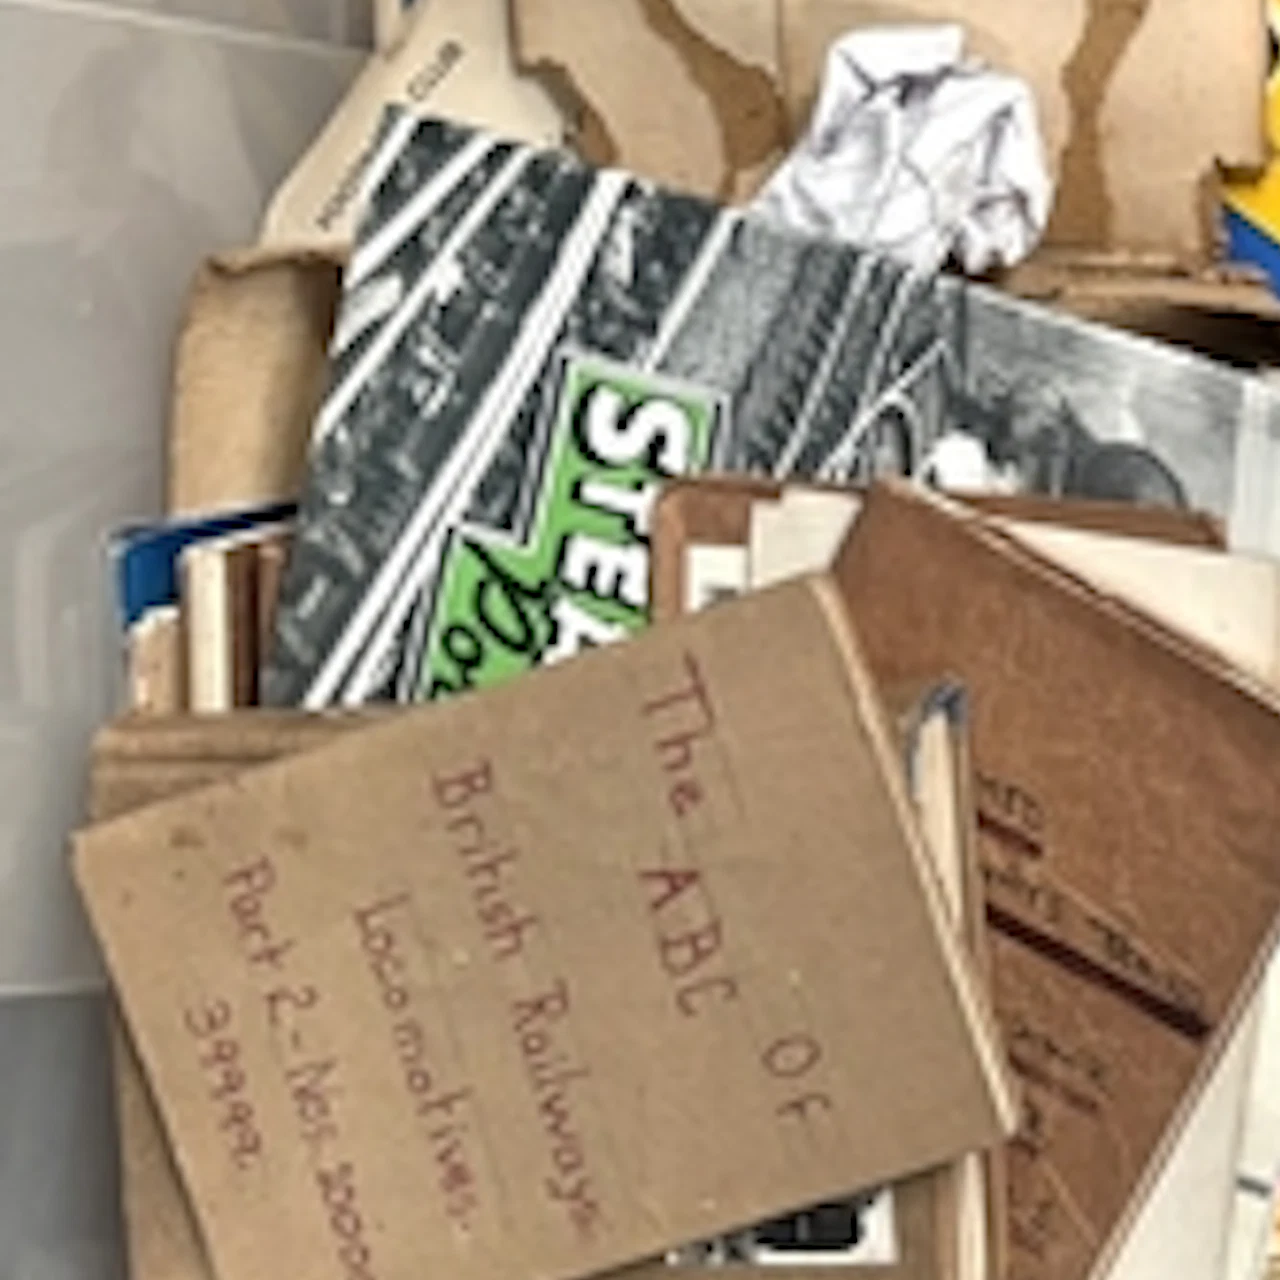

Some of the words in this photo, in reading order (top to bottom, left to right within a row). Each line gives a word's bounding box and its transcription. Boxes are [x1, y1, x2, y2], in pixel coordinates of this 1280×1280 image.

[641, 649, 716, 819] The
[223, 855, 297, 971] Part
[431, 758, 540, 962] British
[640, 862, 738, 1018] ABC
